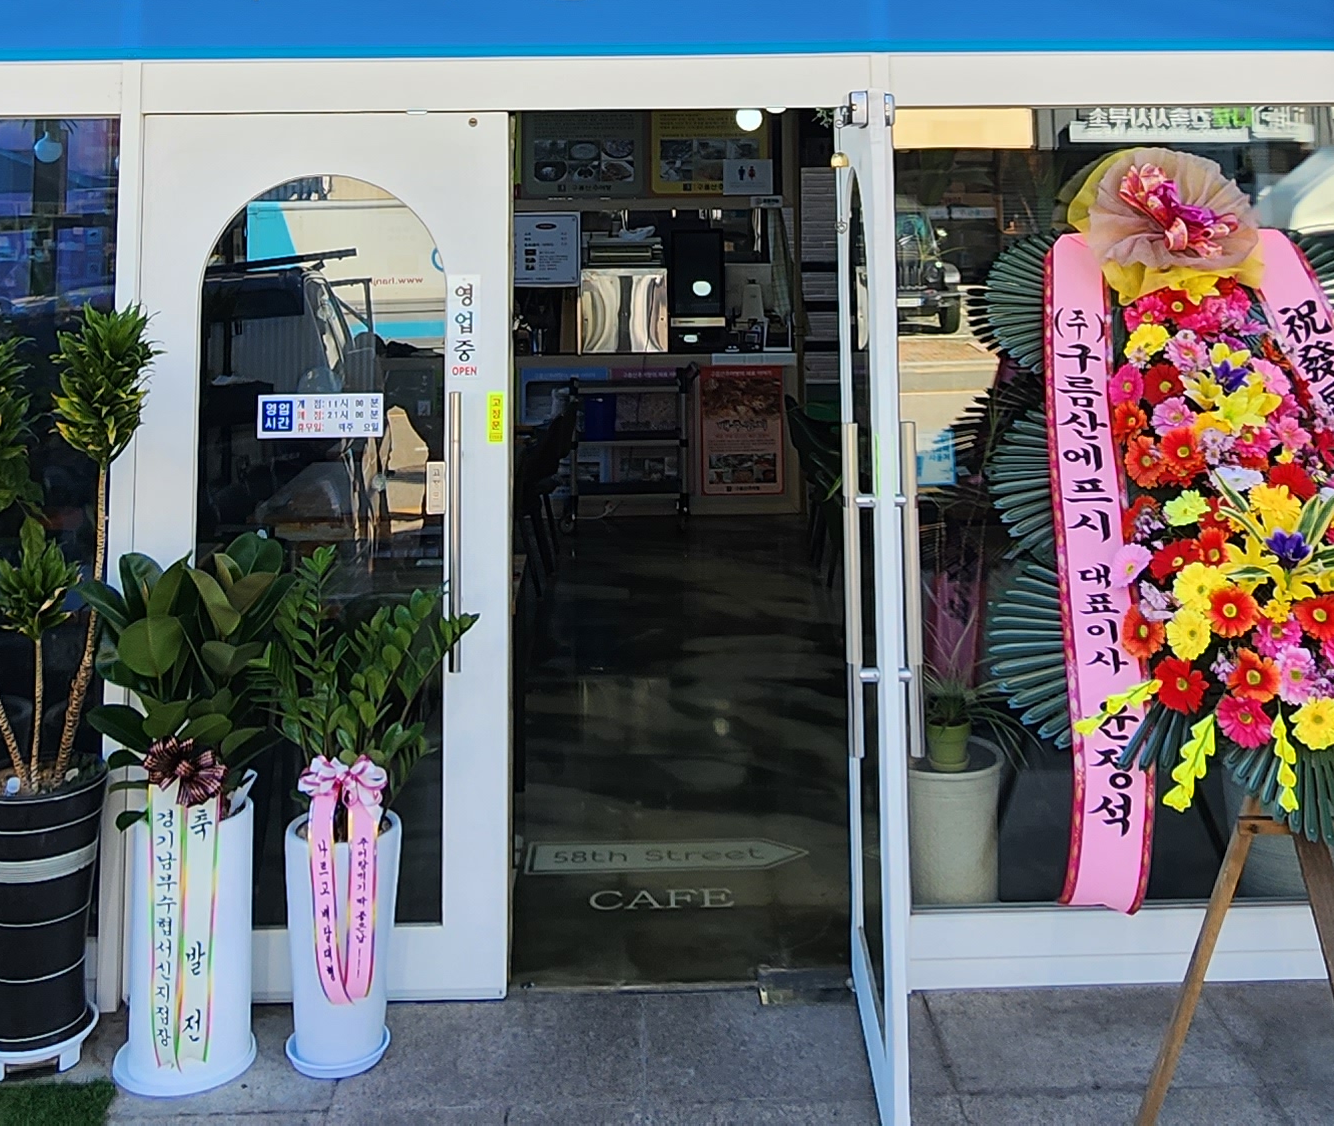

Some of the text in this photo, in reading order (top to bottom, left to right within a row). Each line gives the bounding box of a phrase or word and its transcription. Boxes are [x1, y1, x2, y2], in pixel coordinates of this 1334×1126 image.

[453, 283, 476, 362] 영업중
[452, 366, 477, 376] OPEN
[266, 403, 290, 416] 영업
[265, 417, 290, 430] 시간
[1077, 562, 1130, 675] 대표이사
[190, 809, 213, 841] 축
[553, 847, 766, 864] 58th Street
[588, 888, 736, 911] CAFE
